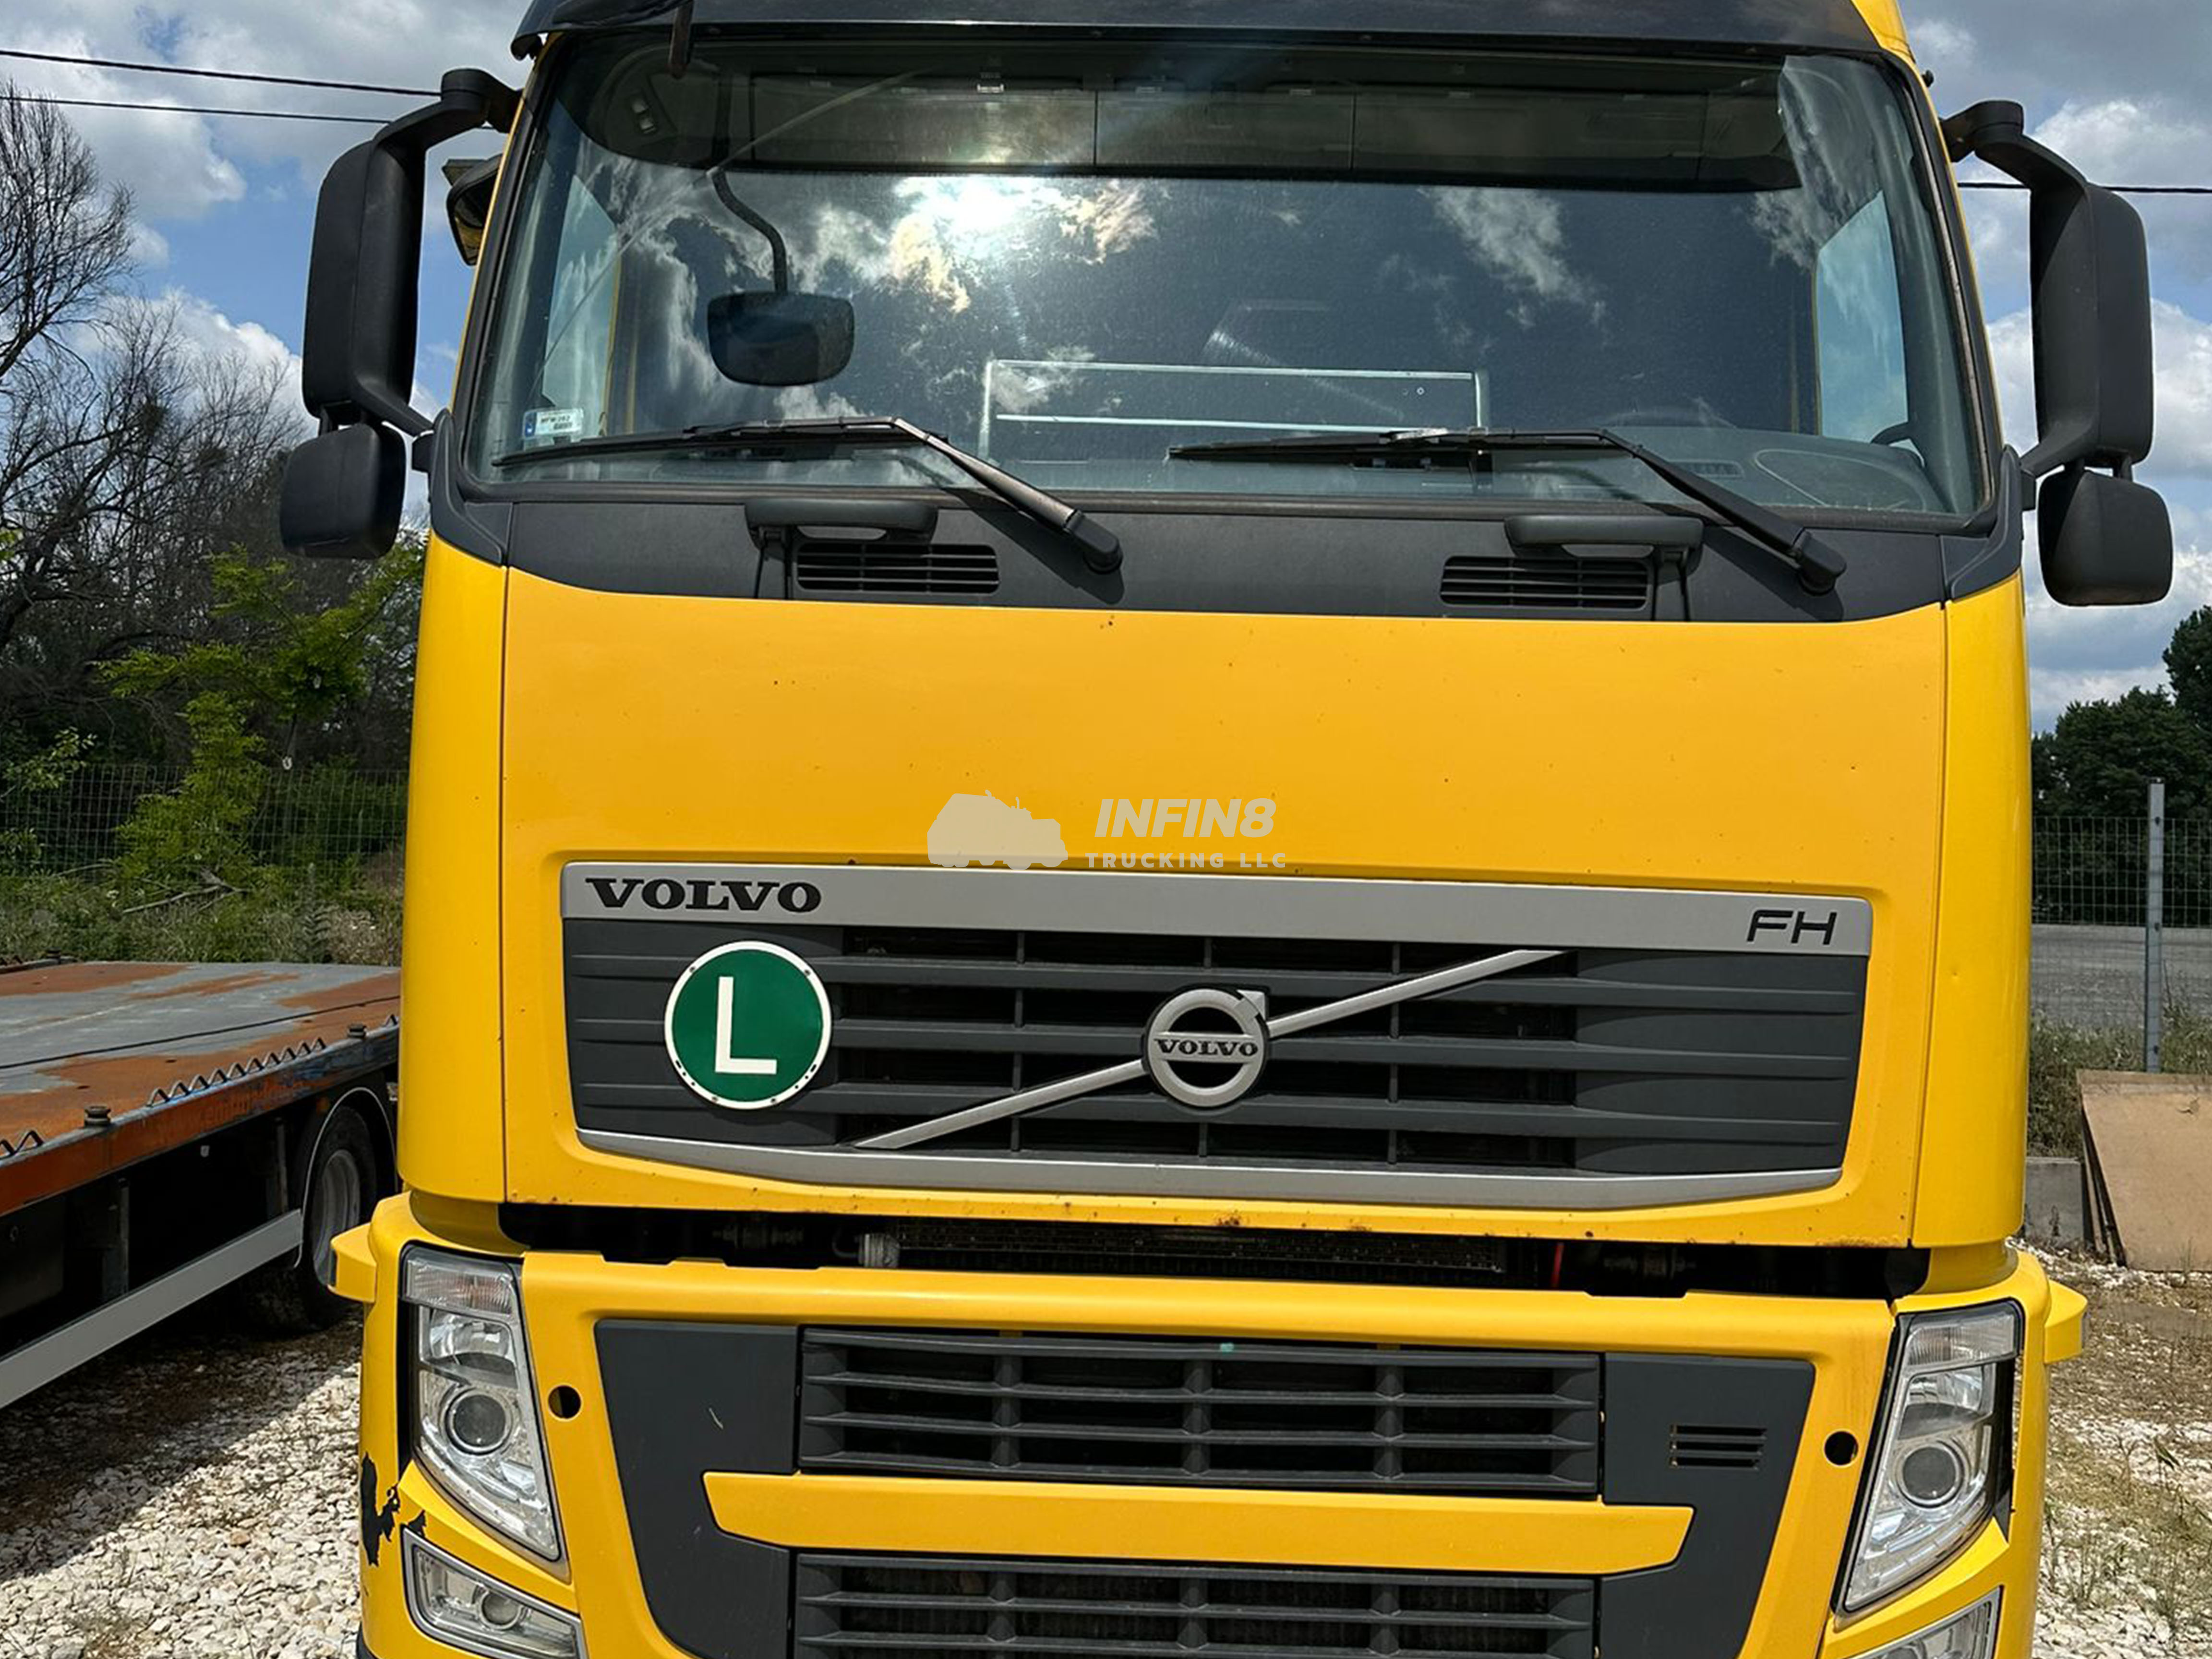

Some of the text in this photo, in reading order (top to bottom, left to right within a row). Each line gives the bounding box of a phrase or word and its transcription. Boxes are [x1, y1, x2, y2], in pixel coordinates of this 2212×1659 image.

[585, 878, 821, 913] VOLVO
[1746, 910, 1837, 945] FH
[715, 976, 777, 1075] L
[1154, 1038, 1258, 1057] VOLVO
